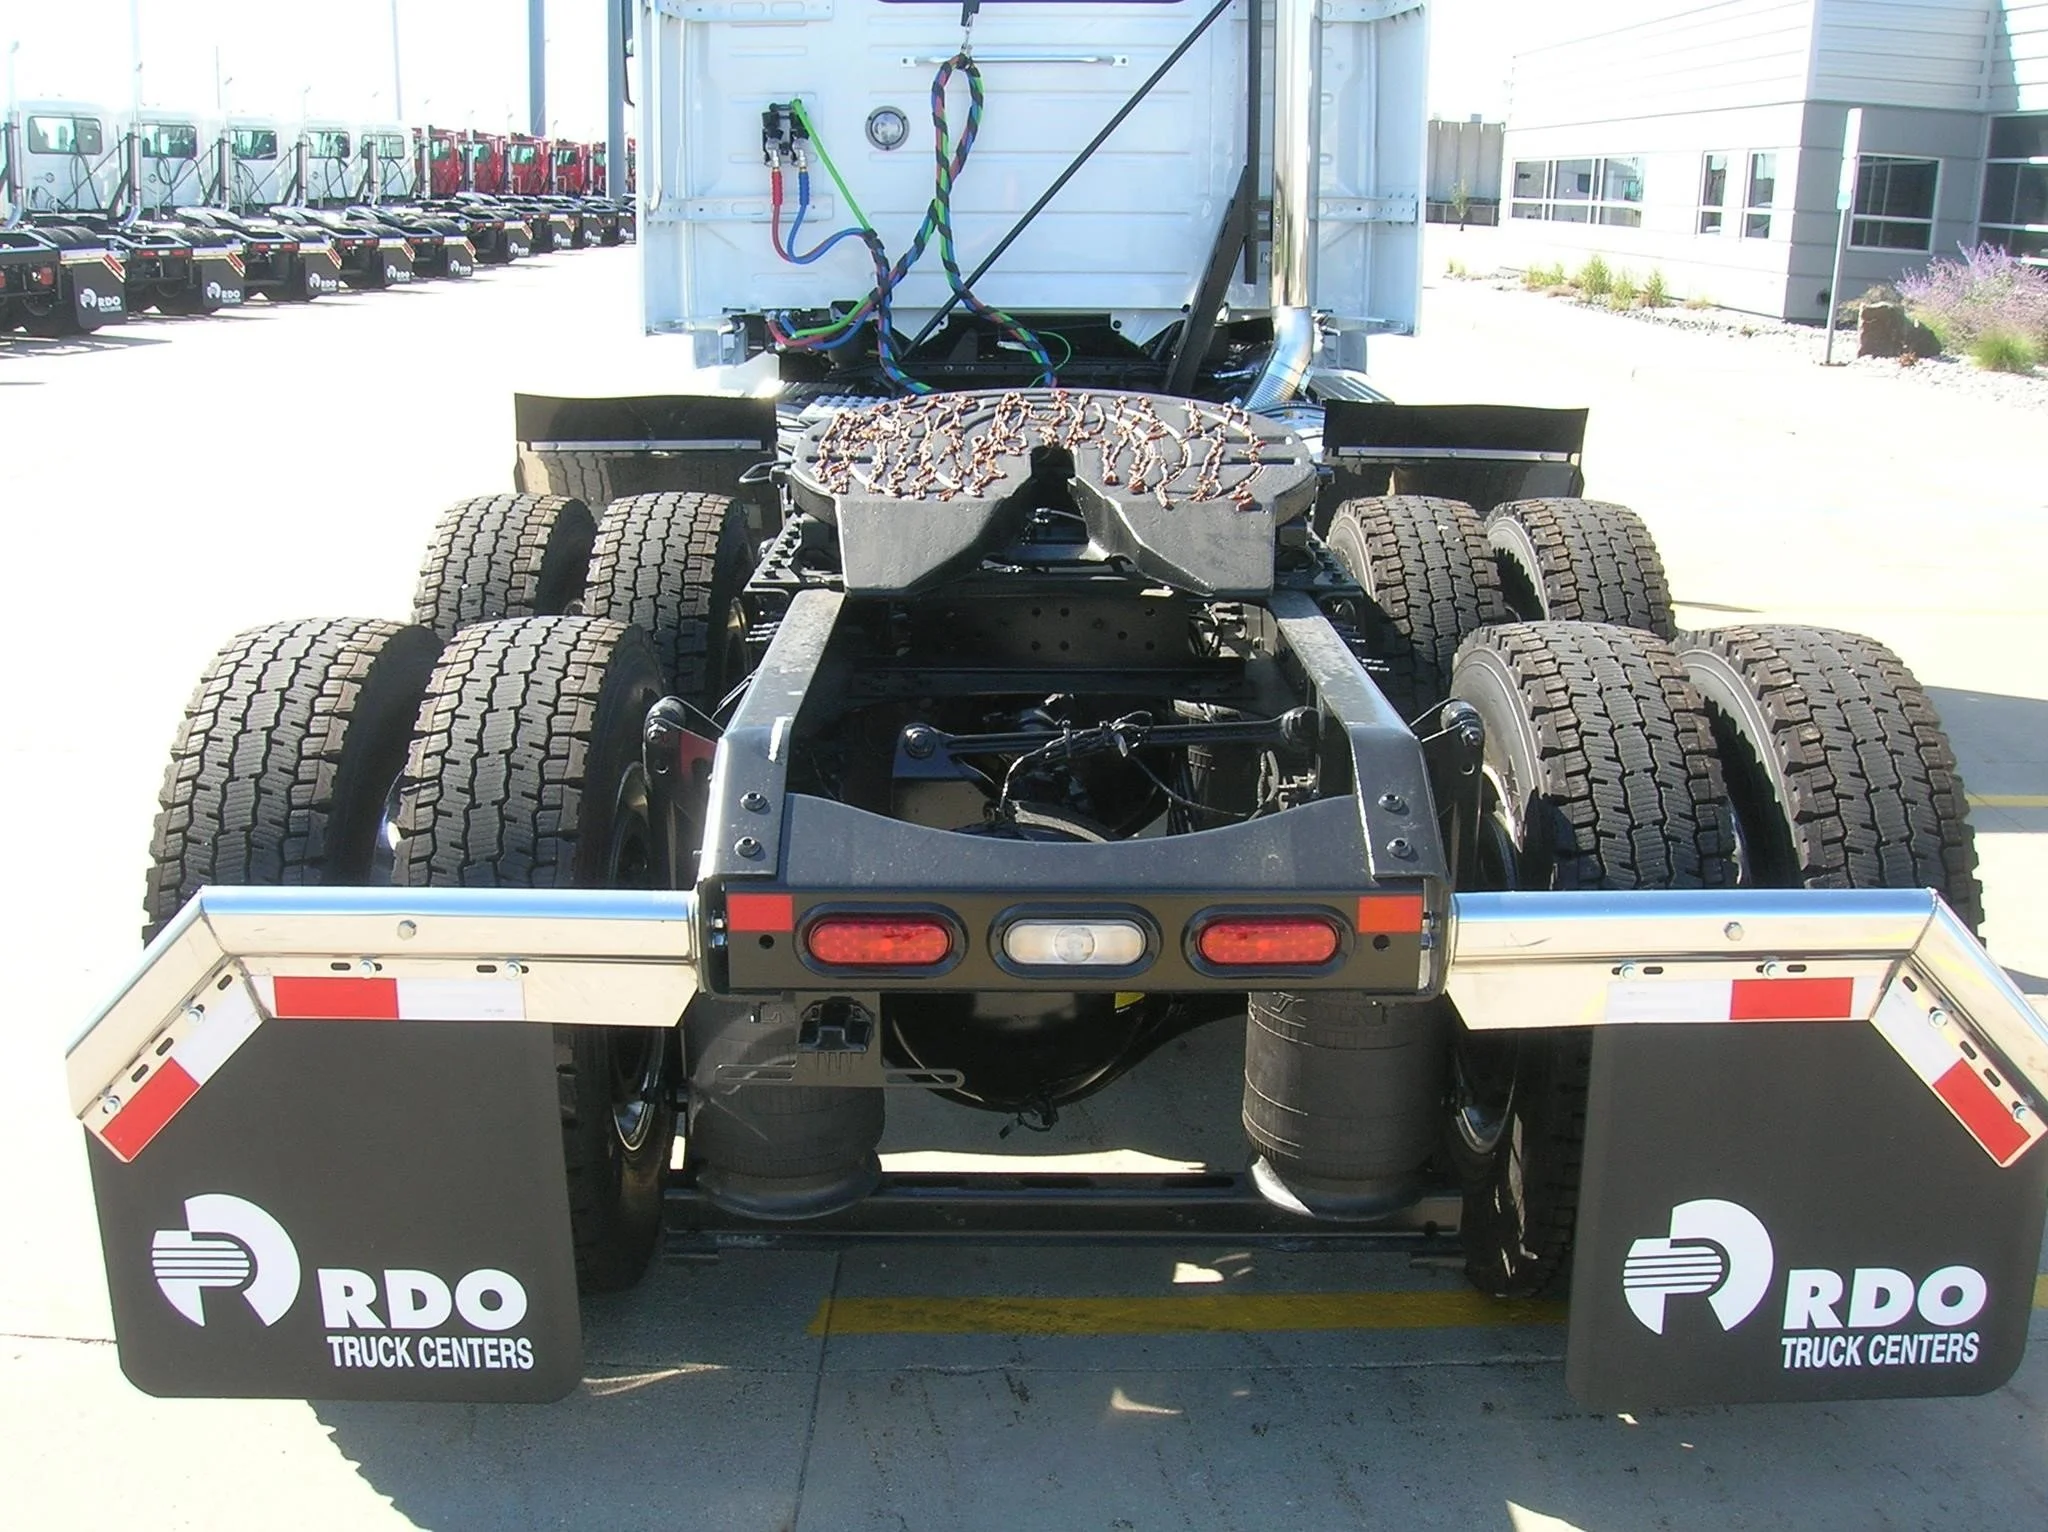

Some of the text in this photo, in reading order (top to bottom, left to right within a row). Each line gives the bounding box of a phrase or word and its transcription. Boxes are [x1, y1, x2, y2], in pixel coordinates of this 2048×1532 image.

[98, 296, 121, 306] RDO
[222, 290, 240, 299] RDO
[317, 1268, 528, 1331] RDO
[1782, 1265, 1987, 1329] RDO
[326, 1335, 534, 1370] TRUCK CENTERS
[1781, 1331, 1980, 1369] TRUCK CENTERS
